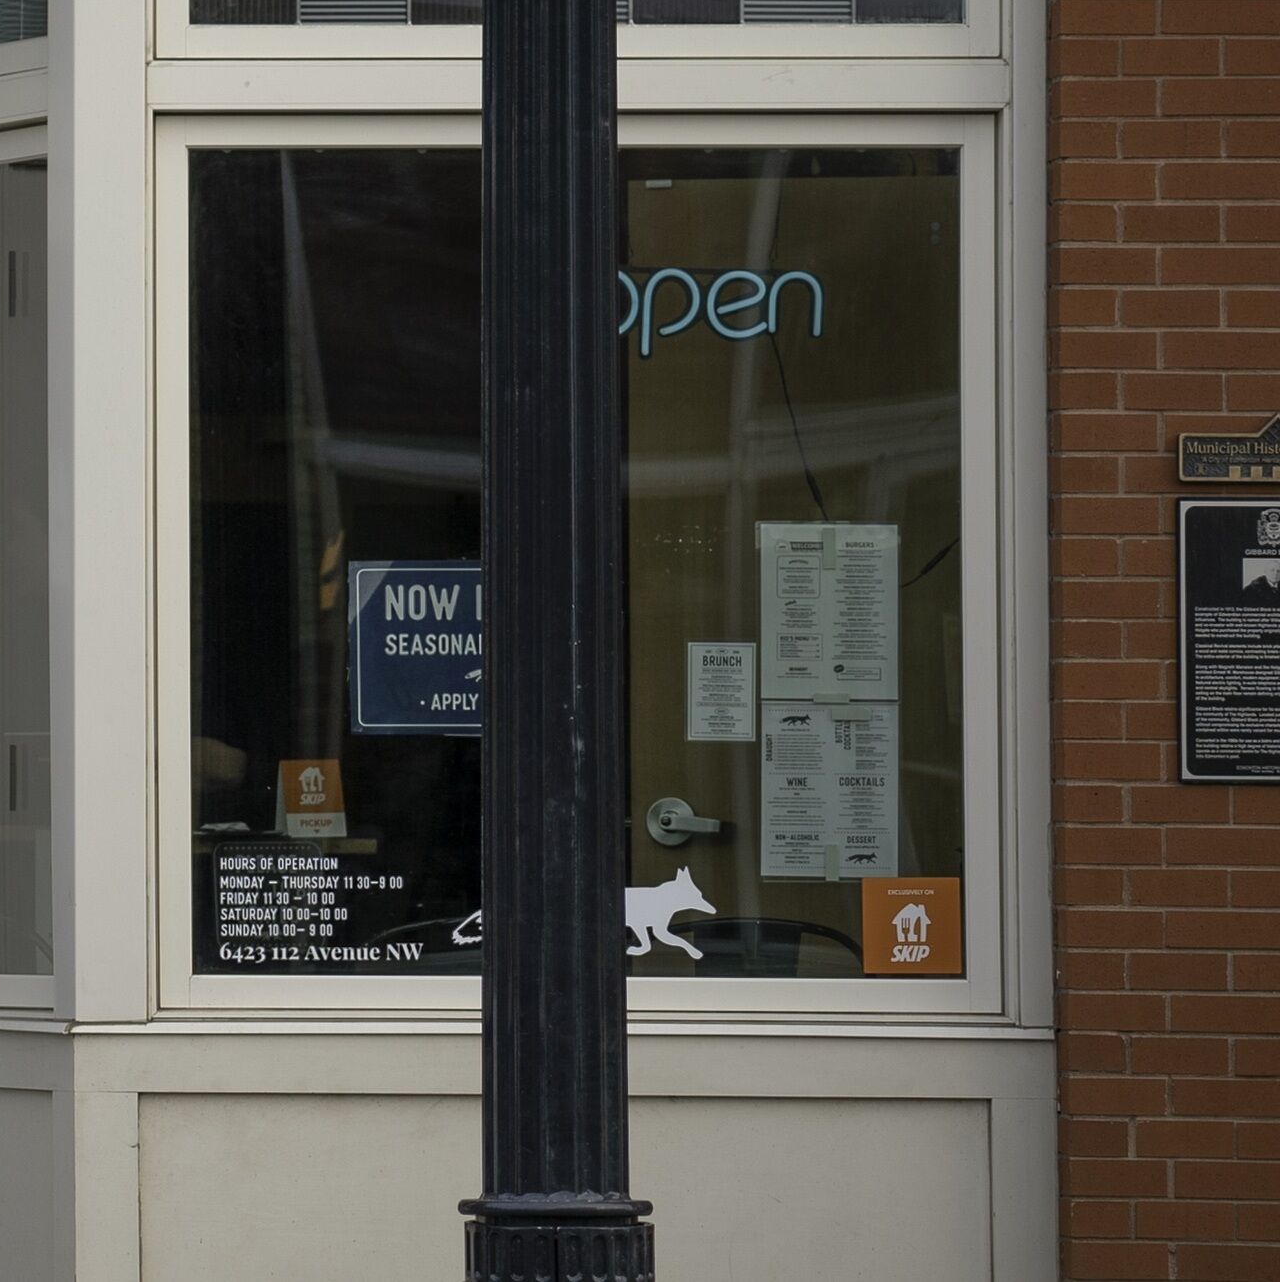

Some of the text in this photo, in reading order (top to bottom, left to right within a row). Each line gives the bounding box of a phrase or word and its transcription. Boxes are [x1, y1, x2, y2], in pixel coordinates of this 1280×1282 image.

[1186, 441, 1280, 456] Municipal Hist
[385, 584, 460, 621] NOW
[702, 655, 742, 667] BRUNCH
[430, 693, 479, 711] APPLY
[786, 777, 808, 787] WINE
[838, 777, 885, 787] COCKTAILS
[299, 793, 327, 806] SKIP
[299, 819, 332, 828] PICKUP
[846, 835, 876, 844] DESSERT
[220, 857, 339, 870] HOURS OF OPERATION
[220, 876, 265, 889] MONDAY
[281, 876, 340, 889] THURSDAY
[220, 892, 259, 905] FRIDAY
[220, 907, 278, 921] SATURDAY
[220, 923, 264, 936] SUNDAY
[219, 941, 424, 963] 6423 112 Avenue NW
[890, 945, 931, 963] SKIP
